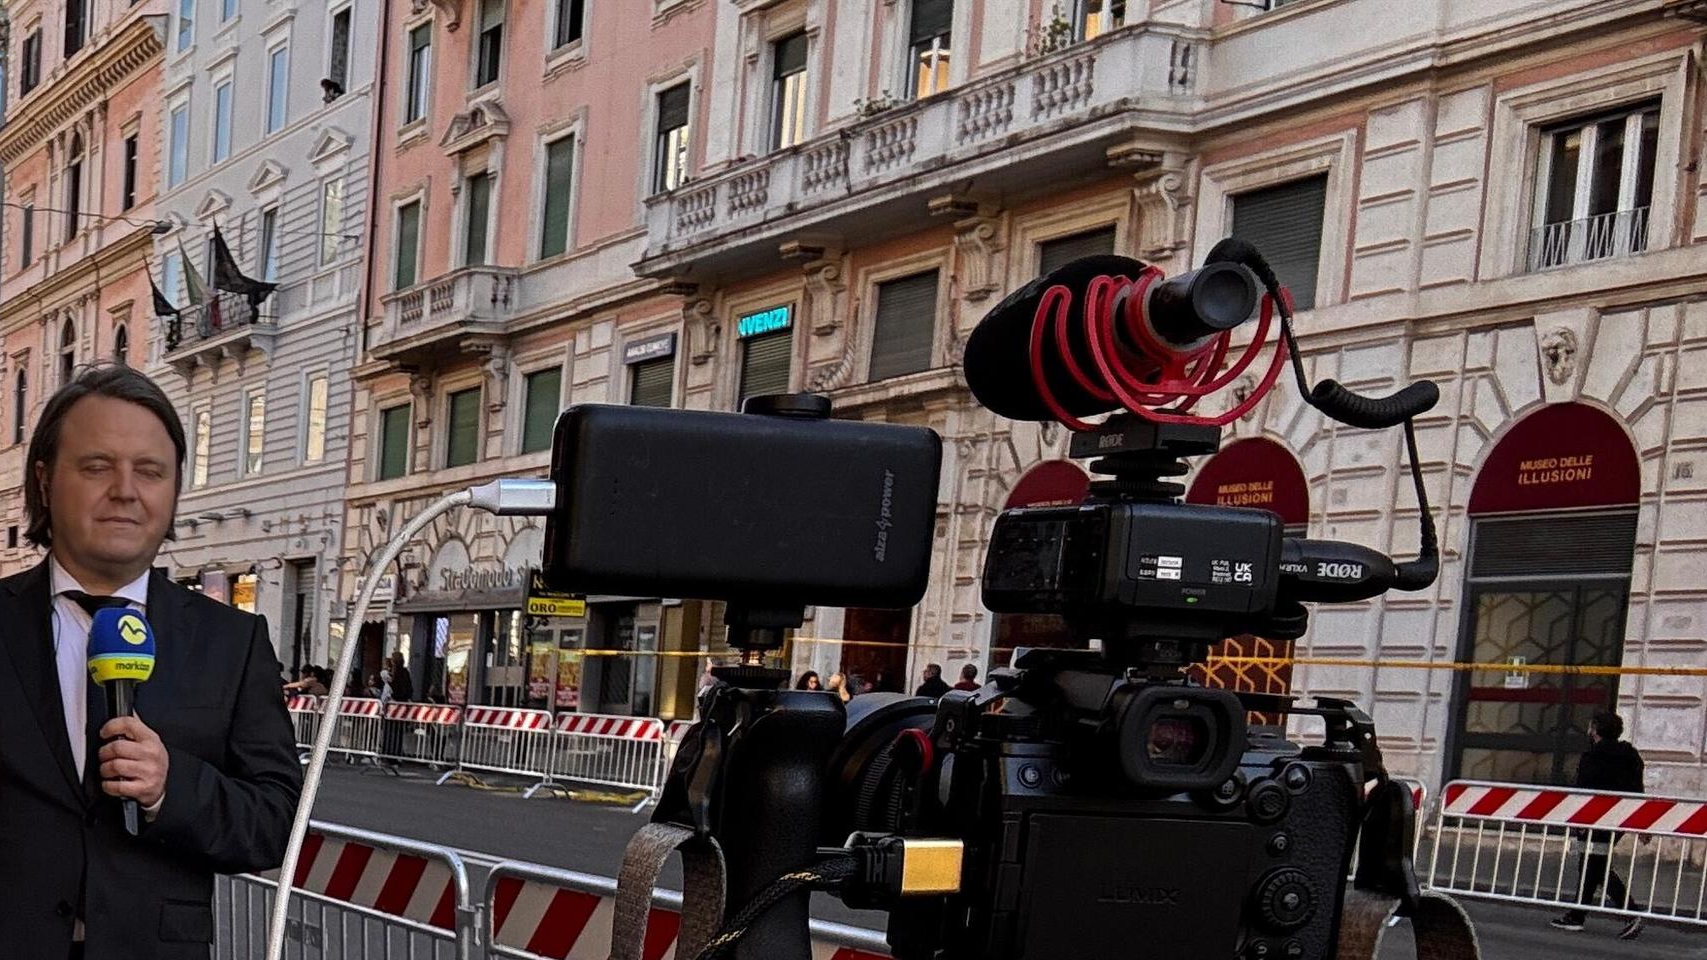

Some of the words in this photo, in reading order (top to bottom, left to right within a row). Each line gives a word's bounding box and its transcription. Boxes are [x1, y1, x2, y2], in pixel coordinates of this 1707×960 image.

[1520, 458, 1557, 470] MUSEO
[1560, 455, 1593, 468] DELLE
[1518, 467, 1592, 485] ILLUSIONI
[1218, 484, 1247, 495] MUSEO
[1249, 480, 1274, 492] DELLE
[1217, 492, 1274, 505] ILLUSIONI
[1235, 562, 1253, 573] UK
[1316, 562, 1363, 579] RØDE
[1234, 572, 1253, 582] CA
[530, 603, 557, 613] ORO
